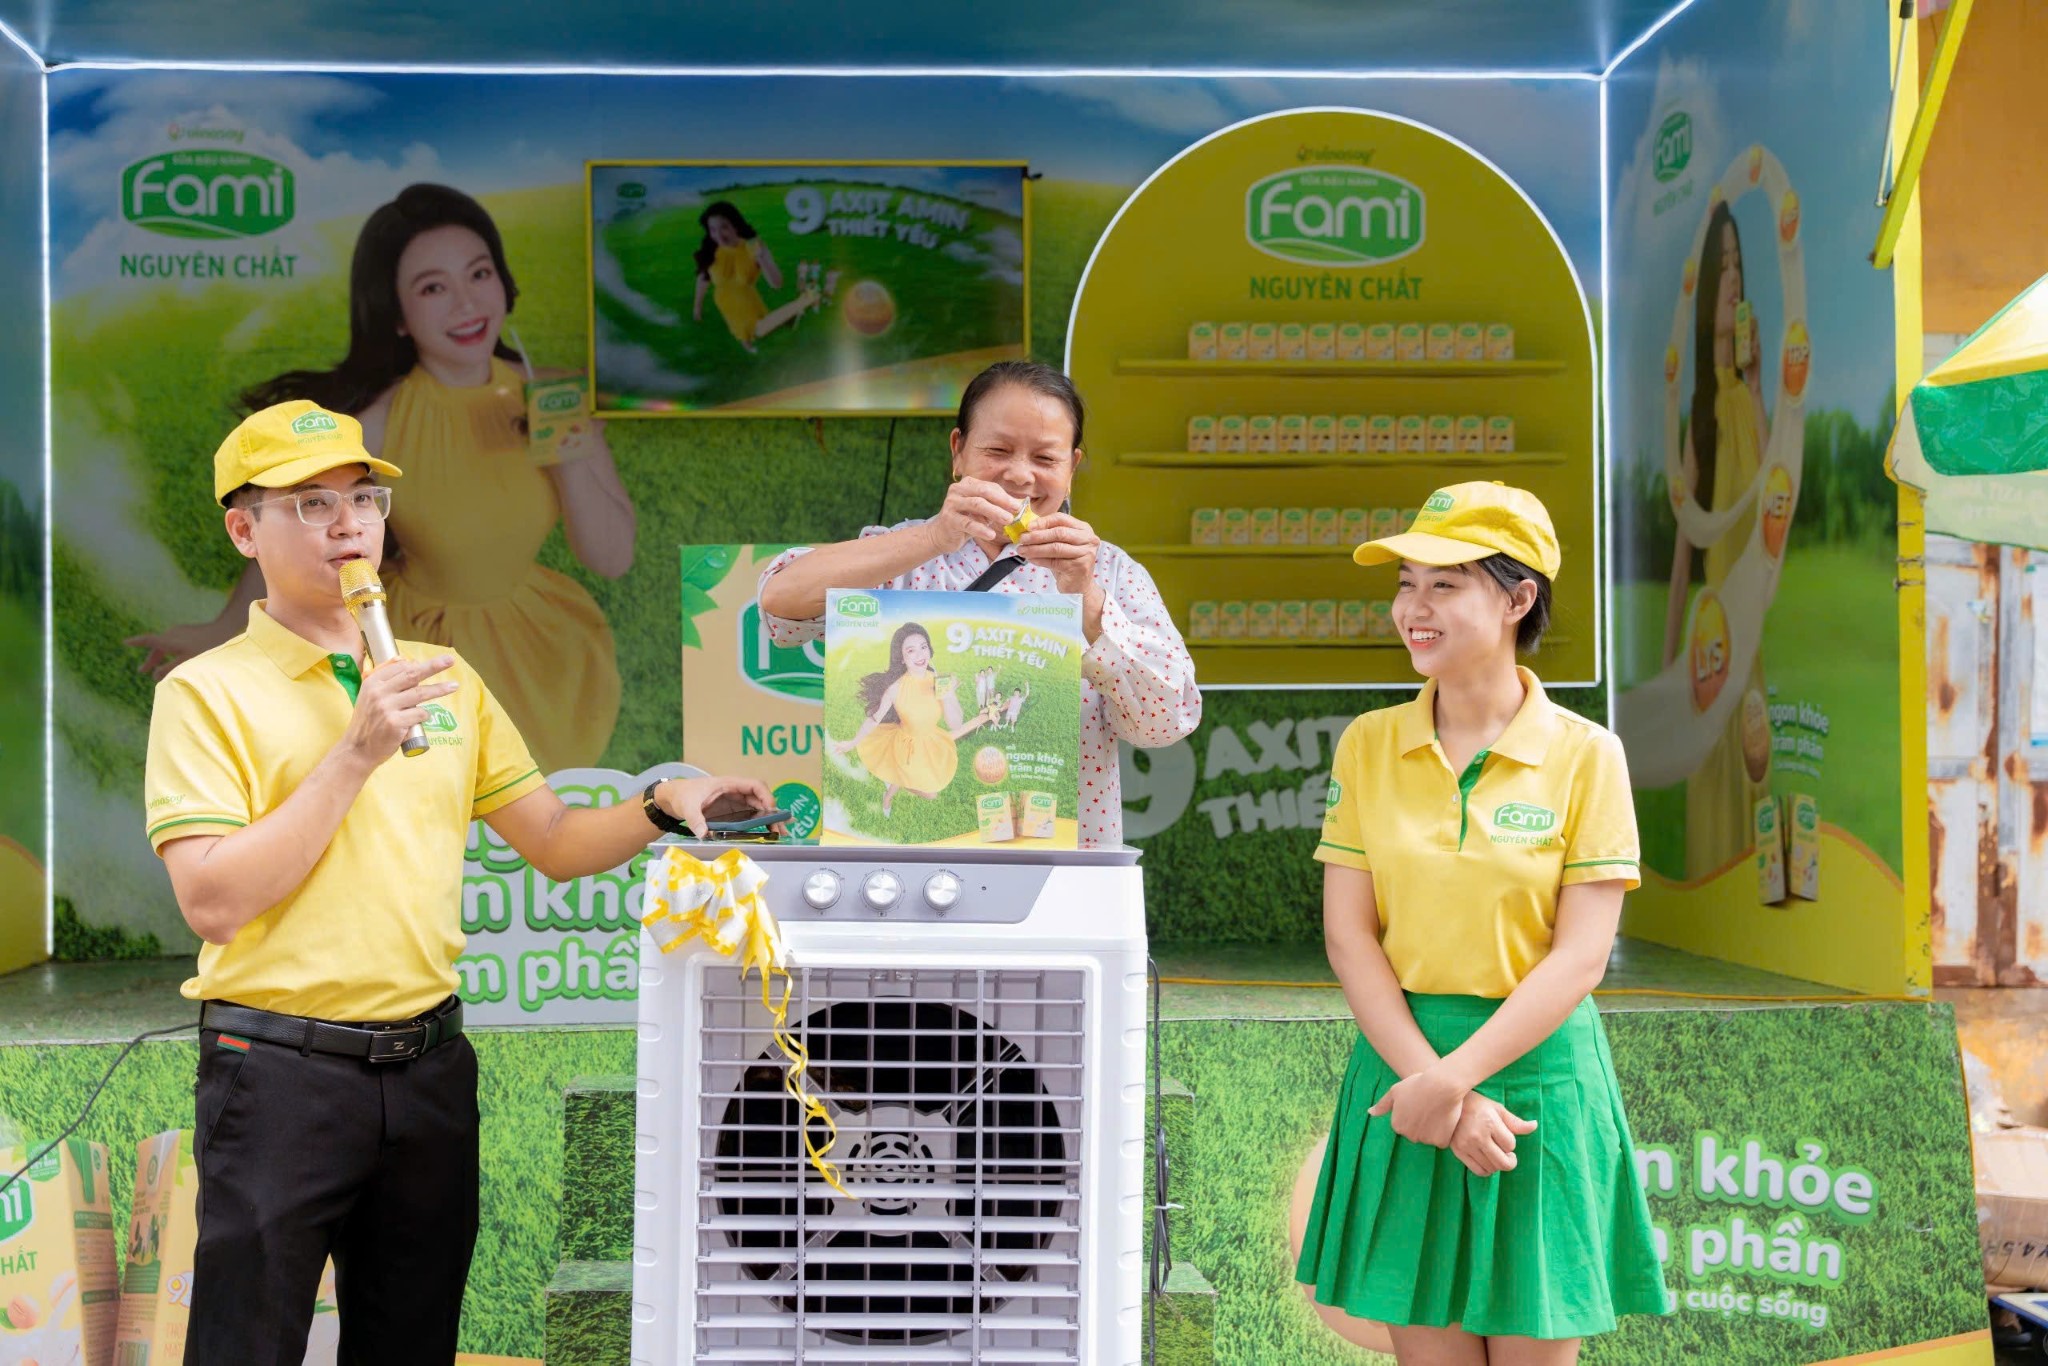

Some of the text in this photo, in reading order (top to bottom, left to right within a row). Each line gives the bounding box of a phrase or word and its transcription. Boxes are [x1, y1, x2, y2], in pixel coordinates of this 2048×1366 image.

[133, 161, 284, 217] Fami
[785, 186, 826, 235] 9
[1261, 181, 1410, 239] Fami
[121, 250, 224, 277] NGUYÊN
[1250, 271, 1350, 299] NGUYÊN
[839, 598, 877, 613] Fami
[946, 622, 1069, 660] 9 AXIT AMIN
[1497, 806, 1551, 826] Fami
[524, 934, 639, 1002] phầ
[1701, 1136, 1872, 1214] khỏe
[1, 1245, 38, 1276] HẤT
[1691, 1217, 1841, 1280] phần
[167, 1275, 187, 1304] 9
[1686, 1285, 1751, 1318] cuộc
[1759, 1291, 1827, 1328] sống
